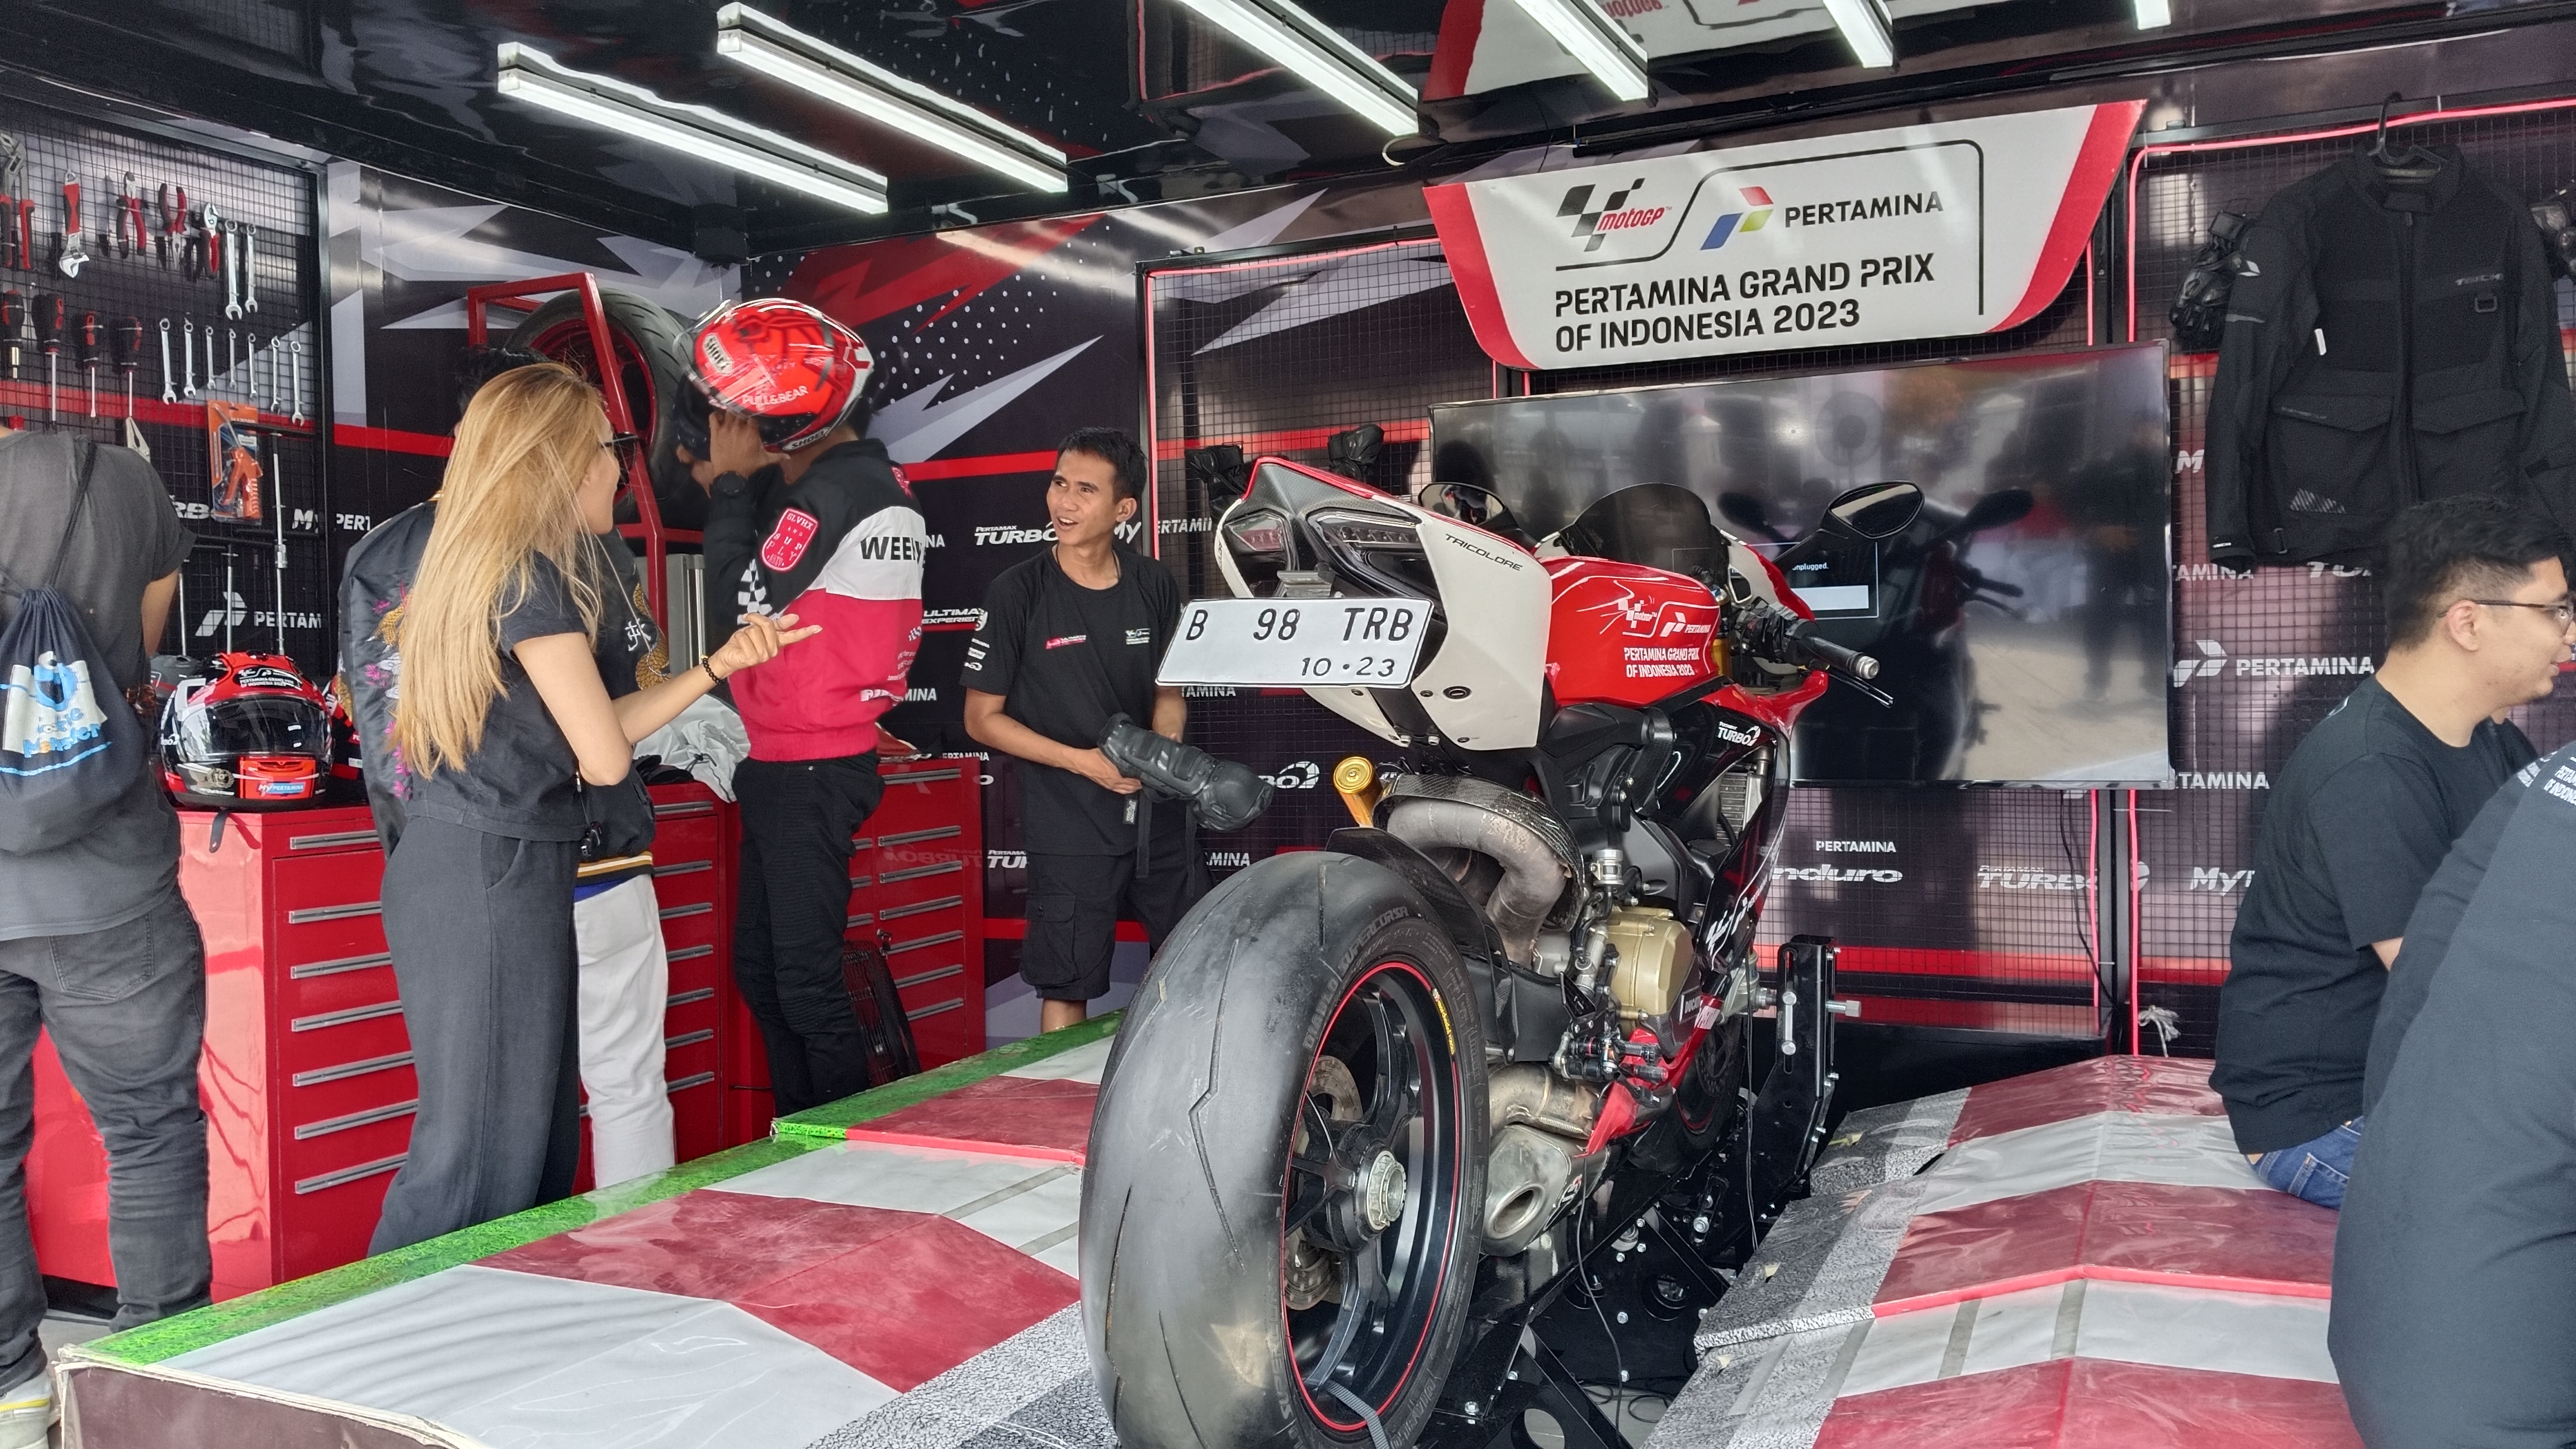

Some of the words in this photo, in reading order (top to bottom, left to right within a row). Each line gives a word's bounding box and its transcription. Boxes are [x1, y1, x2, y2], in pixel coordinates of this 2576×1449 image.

[1784, 191, 1943, 228] PERTAMINA
[1555, 274, 1731, 317] PERTAMINA
[1740, 262, 1850, 299] GRAND
[1860, 253, 1935, 288] PRIX
[1555, 324, 1592, 353] OF
[1600, 308, 1764, 349] INDONESIA
[1774, 299, 1860, 334] 2023
[742, 386, 809, 406] PULL&BEAR
[791, 429, 825, 448] SHOEI
[974, 528, 1059, 546] TURBO
[1446, 533, 1523, 571] TRICOLORE
[2172, 562, 2254, 582] AMINA
[924, 608, 979, 617] ULTIMA
[1185, 609, 1209, 641] B
[1253, 608, 1301, 641] 98
[1343, 607, 1414, 641] TRB
[1623, 647, 1666, 661] PERTAMINA
[1668, 647, 1687, 661] GRAND
[1688, 647, 1700, 660] PRIX
[1626, 664, 1637, 678] OF
[1638, 664, 1678, 677] INDONESIA
[1677, 664, 1695, 676] 2023
[2236, 656, 2374, 676] PERTAMINA
[1718, 726, 1752, 745] TURBO
[2176, 771, 2270, 789] TAMINA
[1816, 841, 1896, 853] PERTAMINA
[1979, 864, 2044, 873] PERTAMAX
